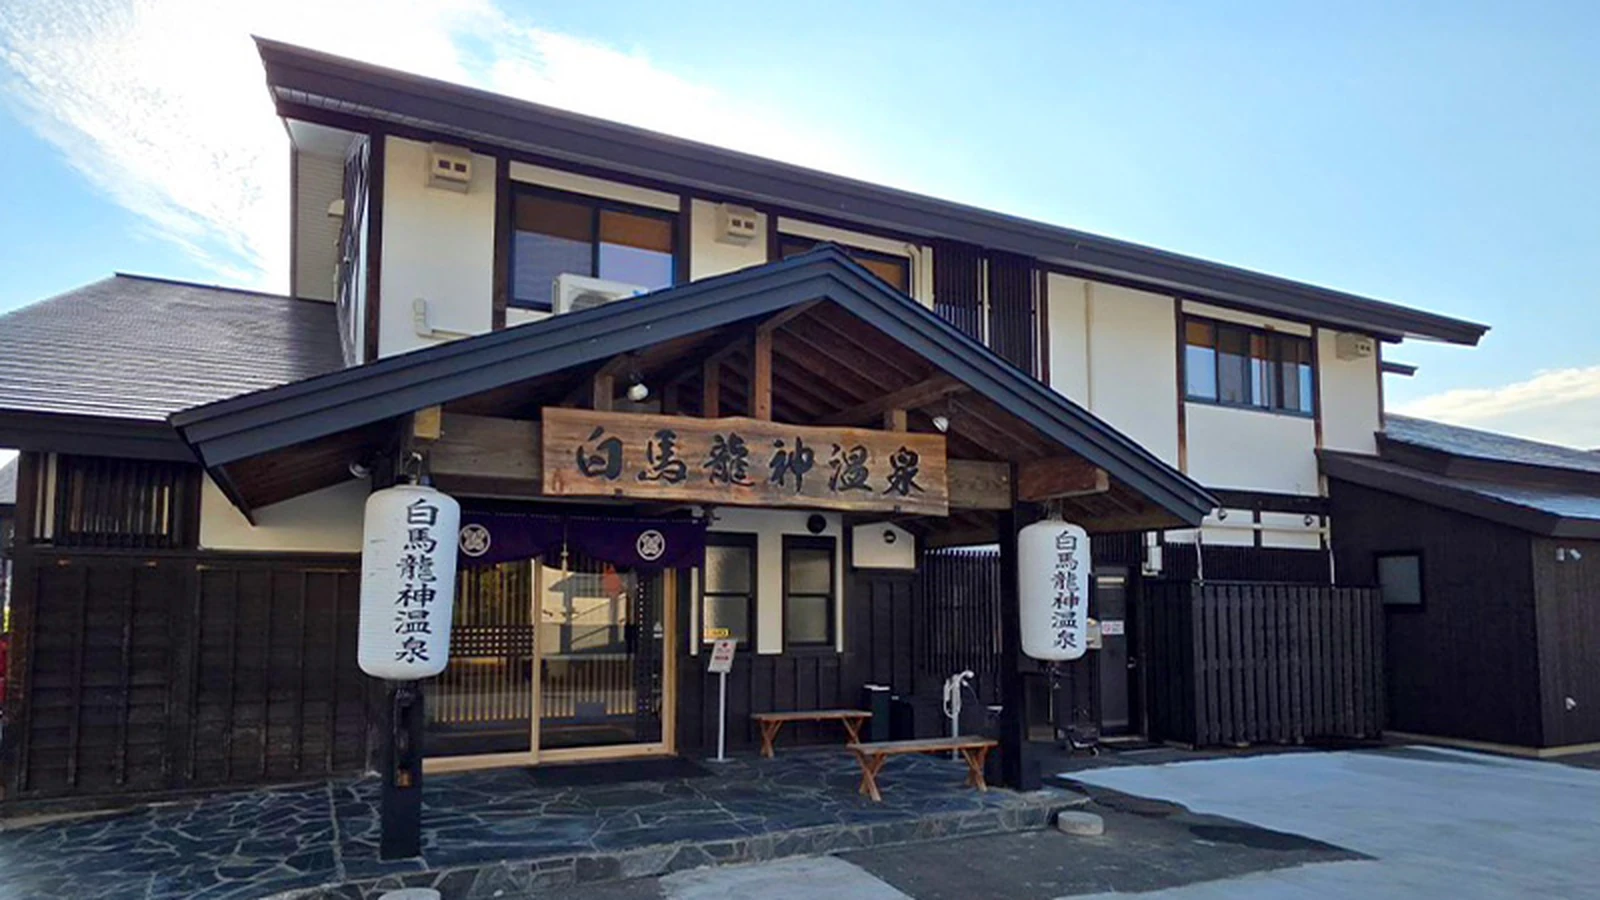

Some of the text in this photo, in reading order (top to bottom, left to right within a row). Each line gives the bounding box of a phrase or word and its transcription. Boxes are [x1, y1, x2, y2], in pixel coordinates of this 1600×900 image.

[576, 426, 924, 497] 白馬龍神温泉
[395, 498, 439, 663] 白馬龍神温泉
[1051, 530, 1079, 649] 白馬龍神温泉
